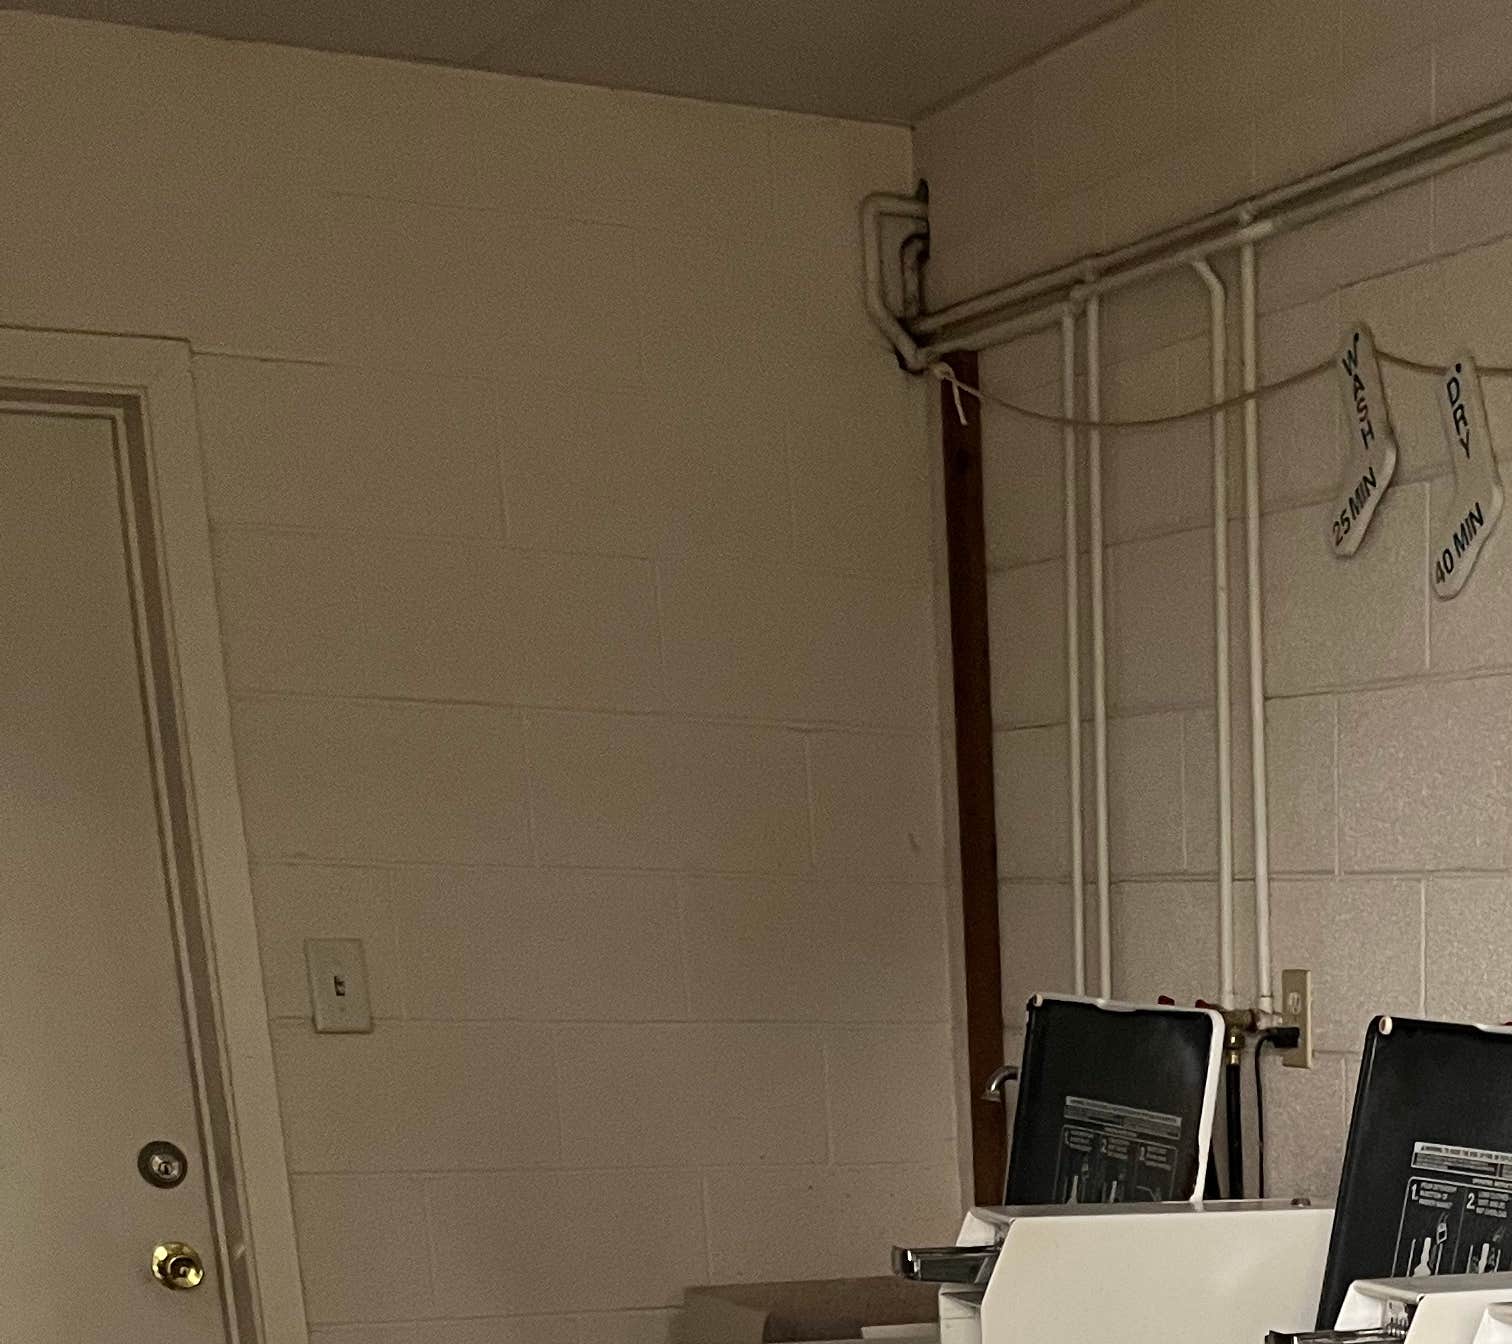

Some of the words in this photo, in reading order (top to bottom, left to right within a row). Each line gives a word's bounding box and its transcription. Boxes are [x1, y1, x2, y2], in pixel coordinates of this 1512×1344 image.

[1342, 340, 1375, 449] WASH
[1446, 376, 1471, 459] DRY
[1332, 508, 1350, 547] 25
[1349, 466, 1376, 521] MIN
[1434, 548, 1454, 584] 40
[1452, 502, 1485, 558] MIN
